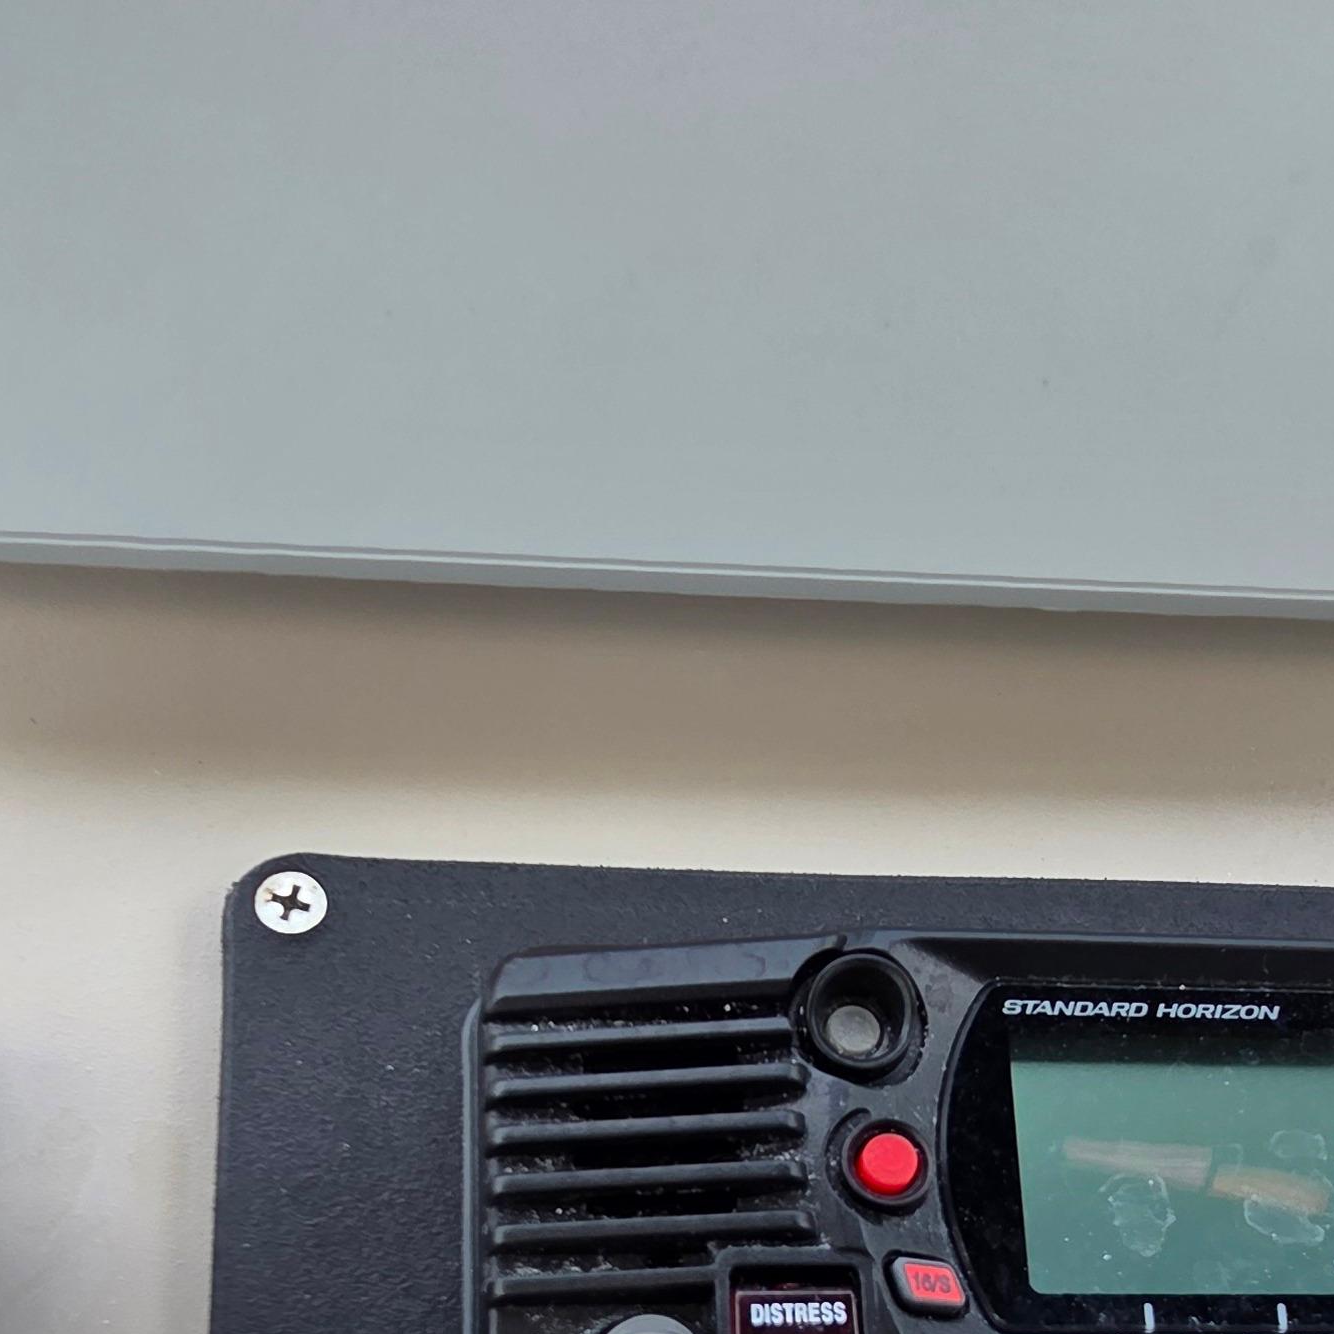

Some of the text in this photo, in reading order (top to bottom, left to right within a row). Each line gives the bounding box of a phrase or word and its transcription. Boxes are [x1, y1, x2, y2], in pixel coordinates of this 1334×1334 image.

[1001, 998, 1280, 1021] STANDARD HORIZON
[912, 1271, 953, 1293] 16/S
[750, 1301, 848, 1327] DISTRESS
